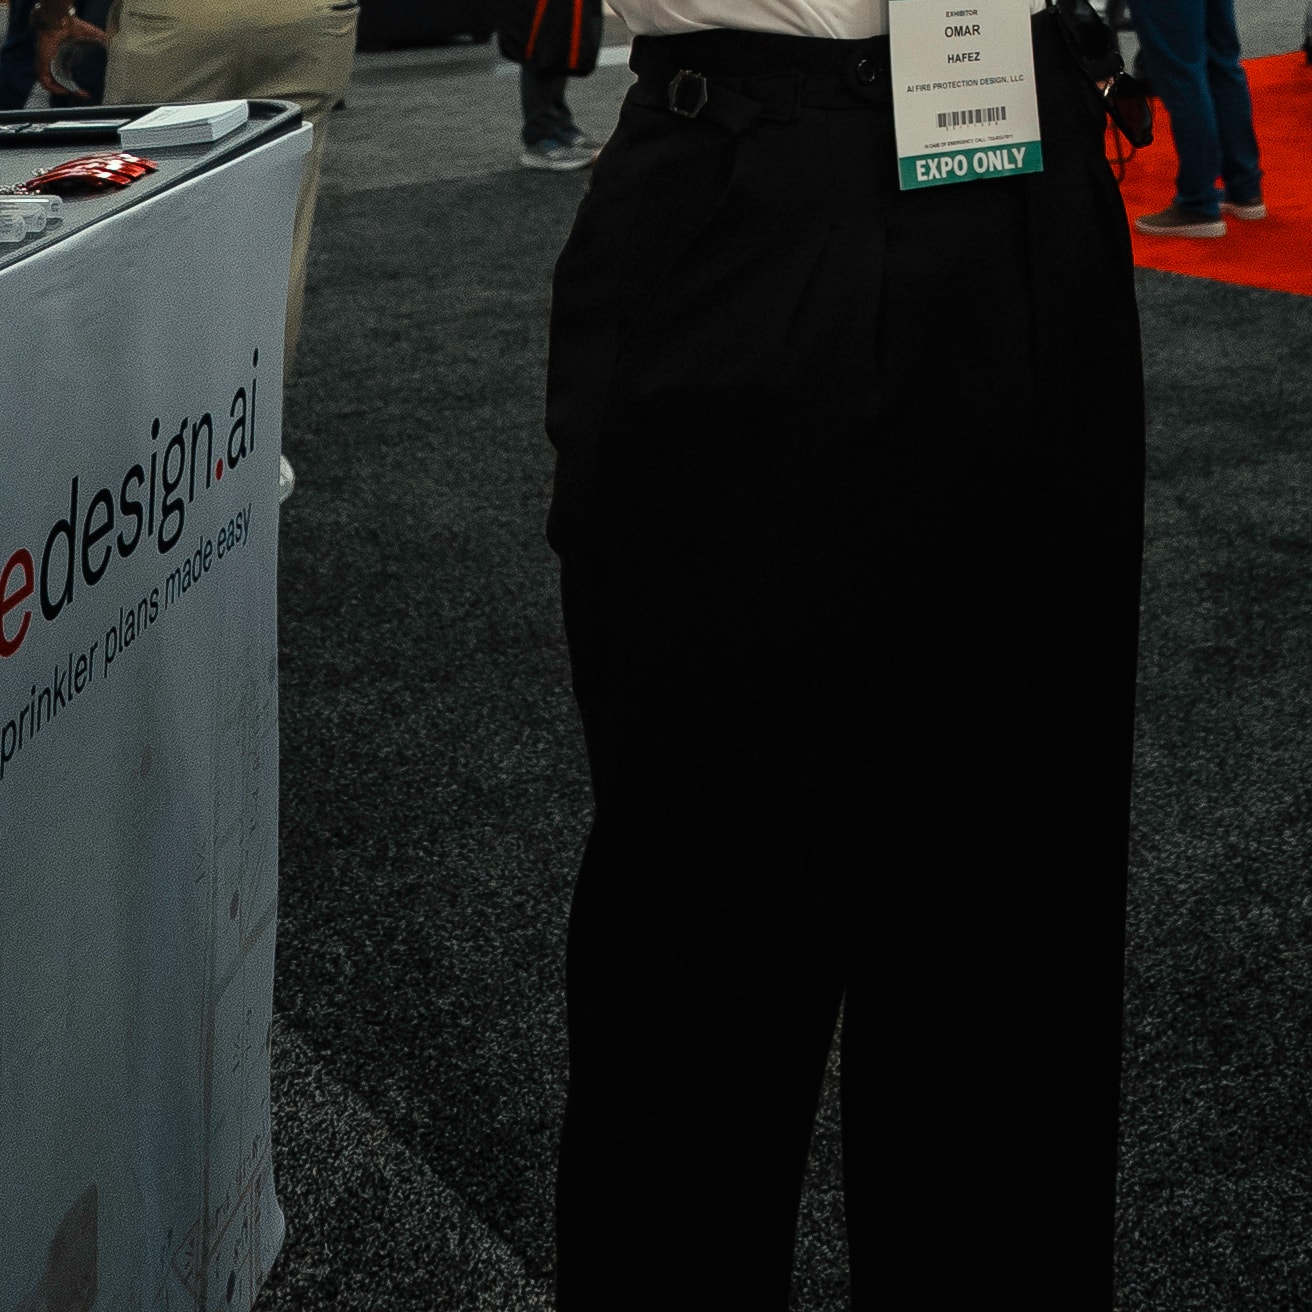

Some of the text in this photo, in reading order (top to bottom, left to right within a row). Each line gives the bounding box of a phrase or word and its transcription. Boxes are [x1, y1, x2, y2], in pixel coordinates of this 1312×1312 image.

[945, 9, 978, 17] EXHIBITOR
[944, 24, 981, 38] OMAR
[947, 52, 981, 64] HAFEZ
[915, 83, 931, 92] FIRE
[932, 79, 979, 90] PROTECTION
[979, 76, 1009, 86] DESIGN,
[1010, 74, 1024, 83] LLC
[915, 146, 1026, 182] EXPO ONLY
[103, 593, 159, 678] plans
[164, 538, 213, 611] made
[216, 503, 252, 560] easy
